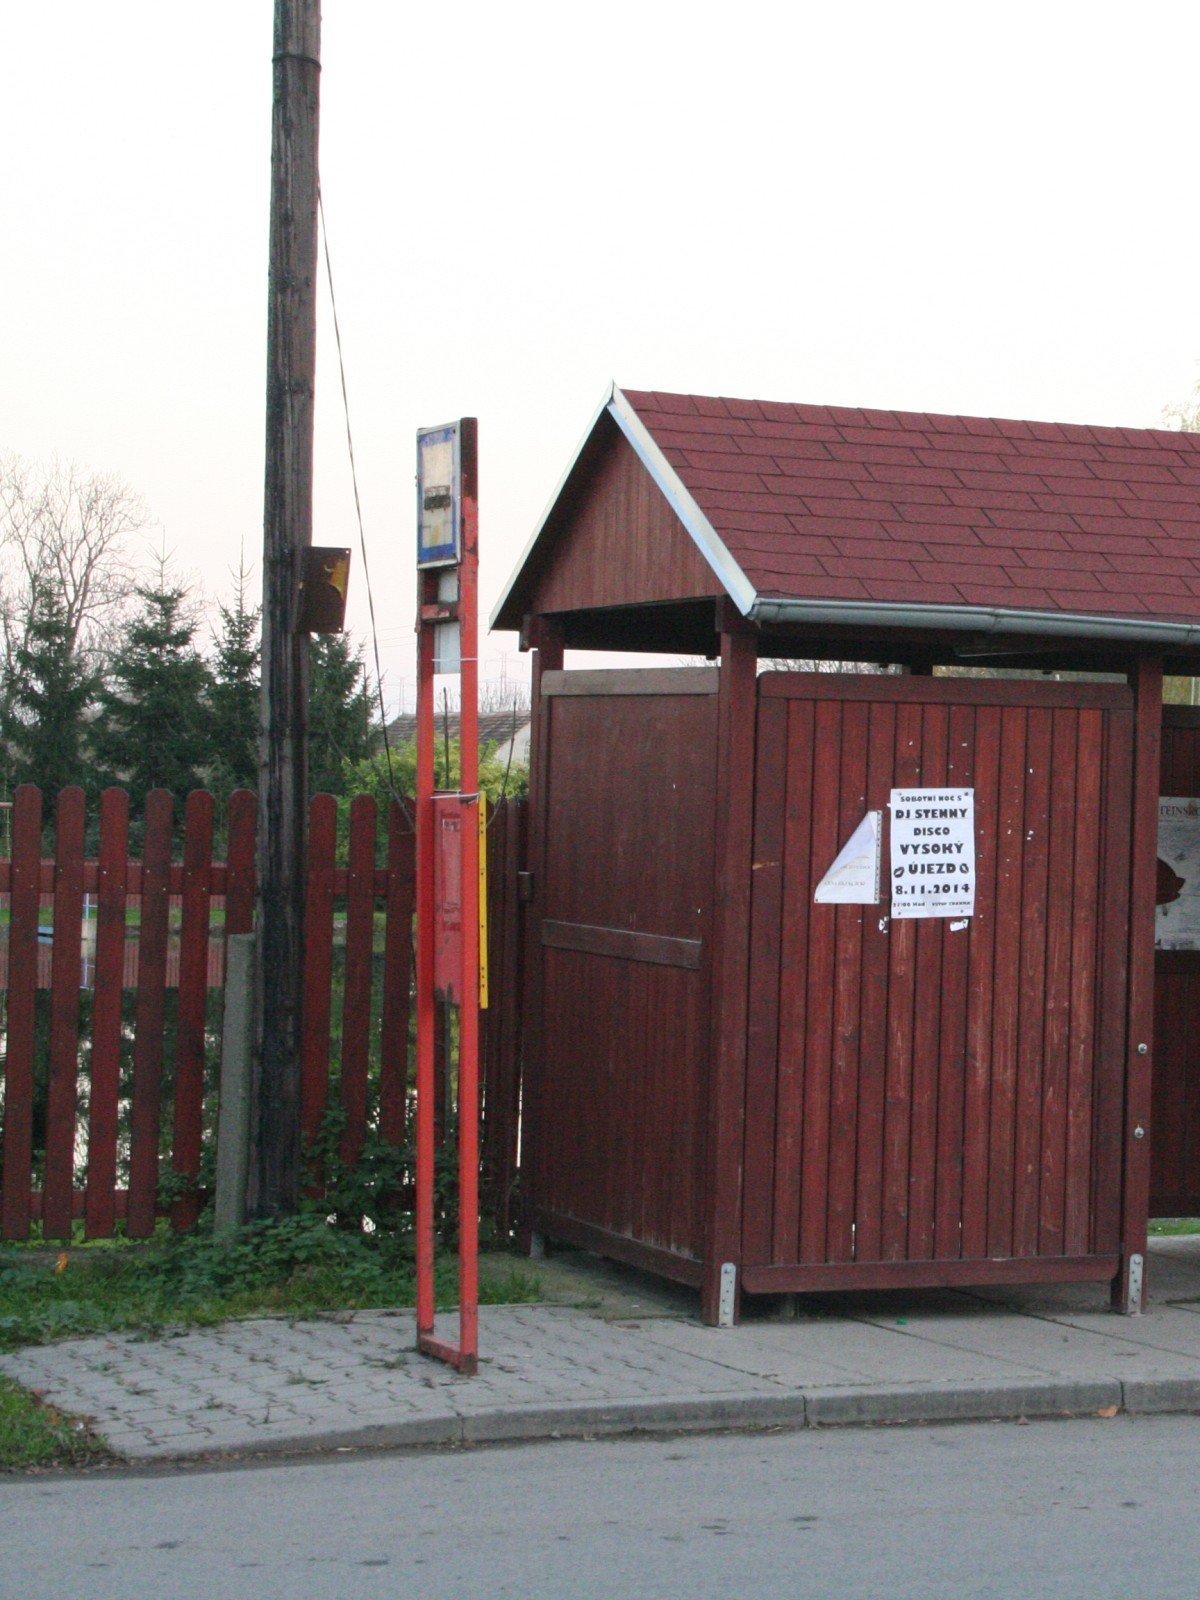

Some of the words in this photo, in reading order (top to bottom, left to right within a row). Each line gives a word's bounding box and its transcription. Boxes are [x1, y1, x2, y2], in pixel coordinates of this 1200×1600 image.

[895, 809, 910, 819] DJ
[914, 808, 968, 819] STENNY
[913, 827, 950, 836] DISCO
[899, 840, 964, 855] VYSOKÝ
[908, 861, 956, 875] ÚJEZD
[895, 883, 970, 895] 8.11.2014
